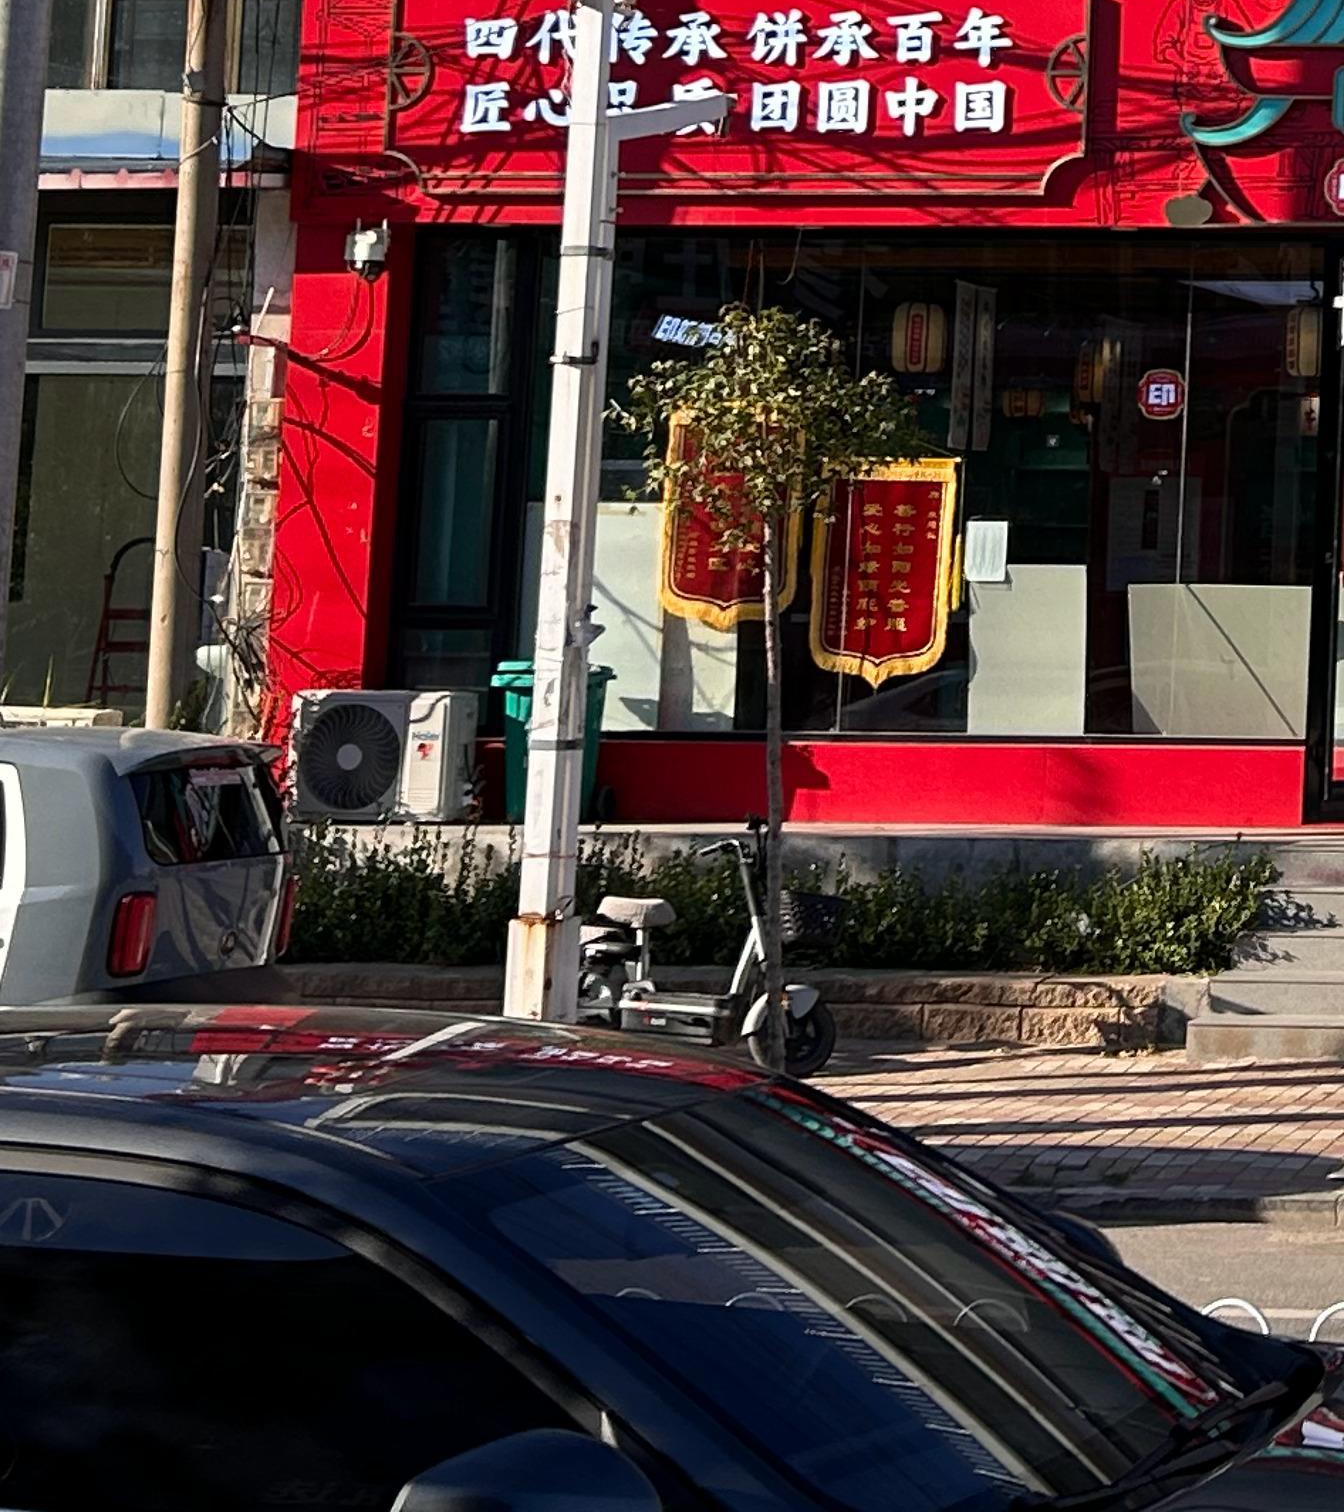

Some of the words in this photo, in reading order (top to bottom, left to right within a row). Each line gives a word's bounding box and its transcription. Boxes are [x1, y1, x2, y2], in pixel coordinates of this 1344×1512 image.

[464, 10, 728, 66] 四代传承
[746, 7, 1013, 68] 饼承百年
[751, 76, 1006, 136] 团圆中国
